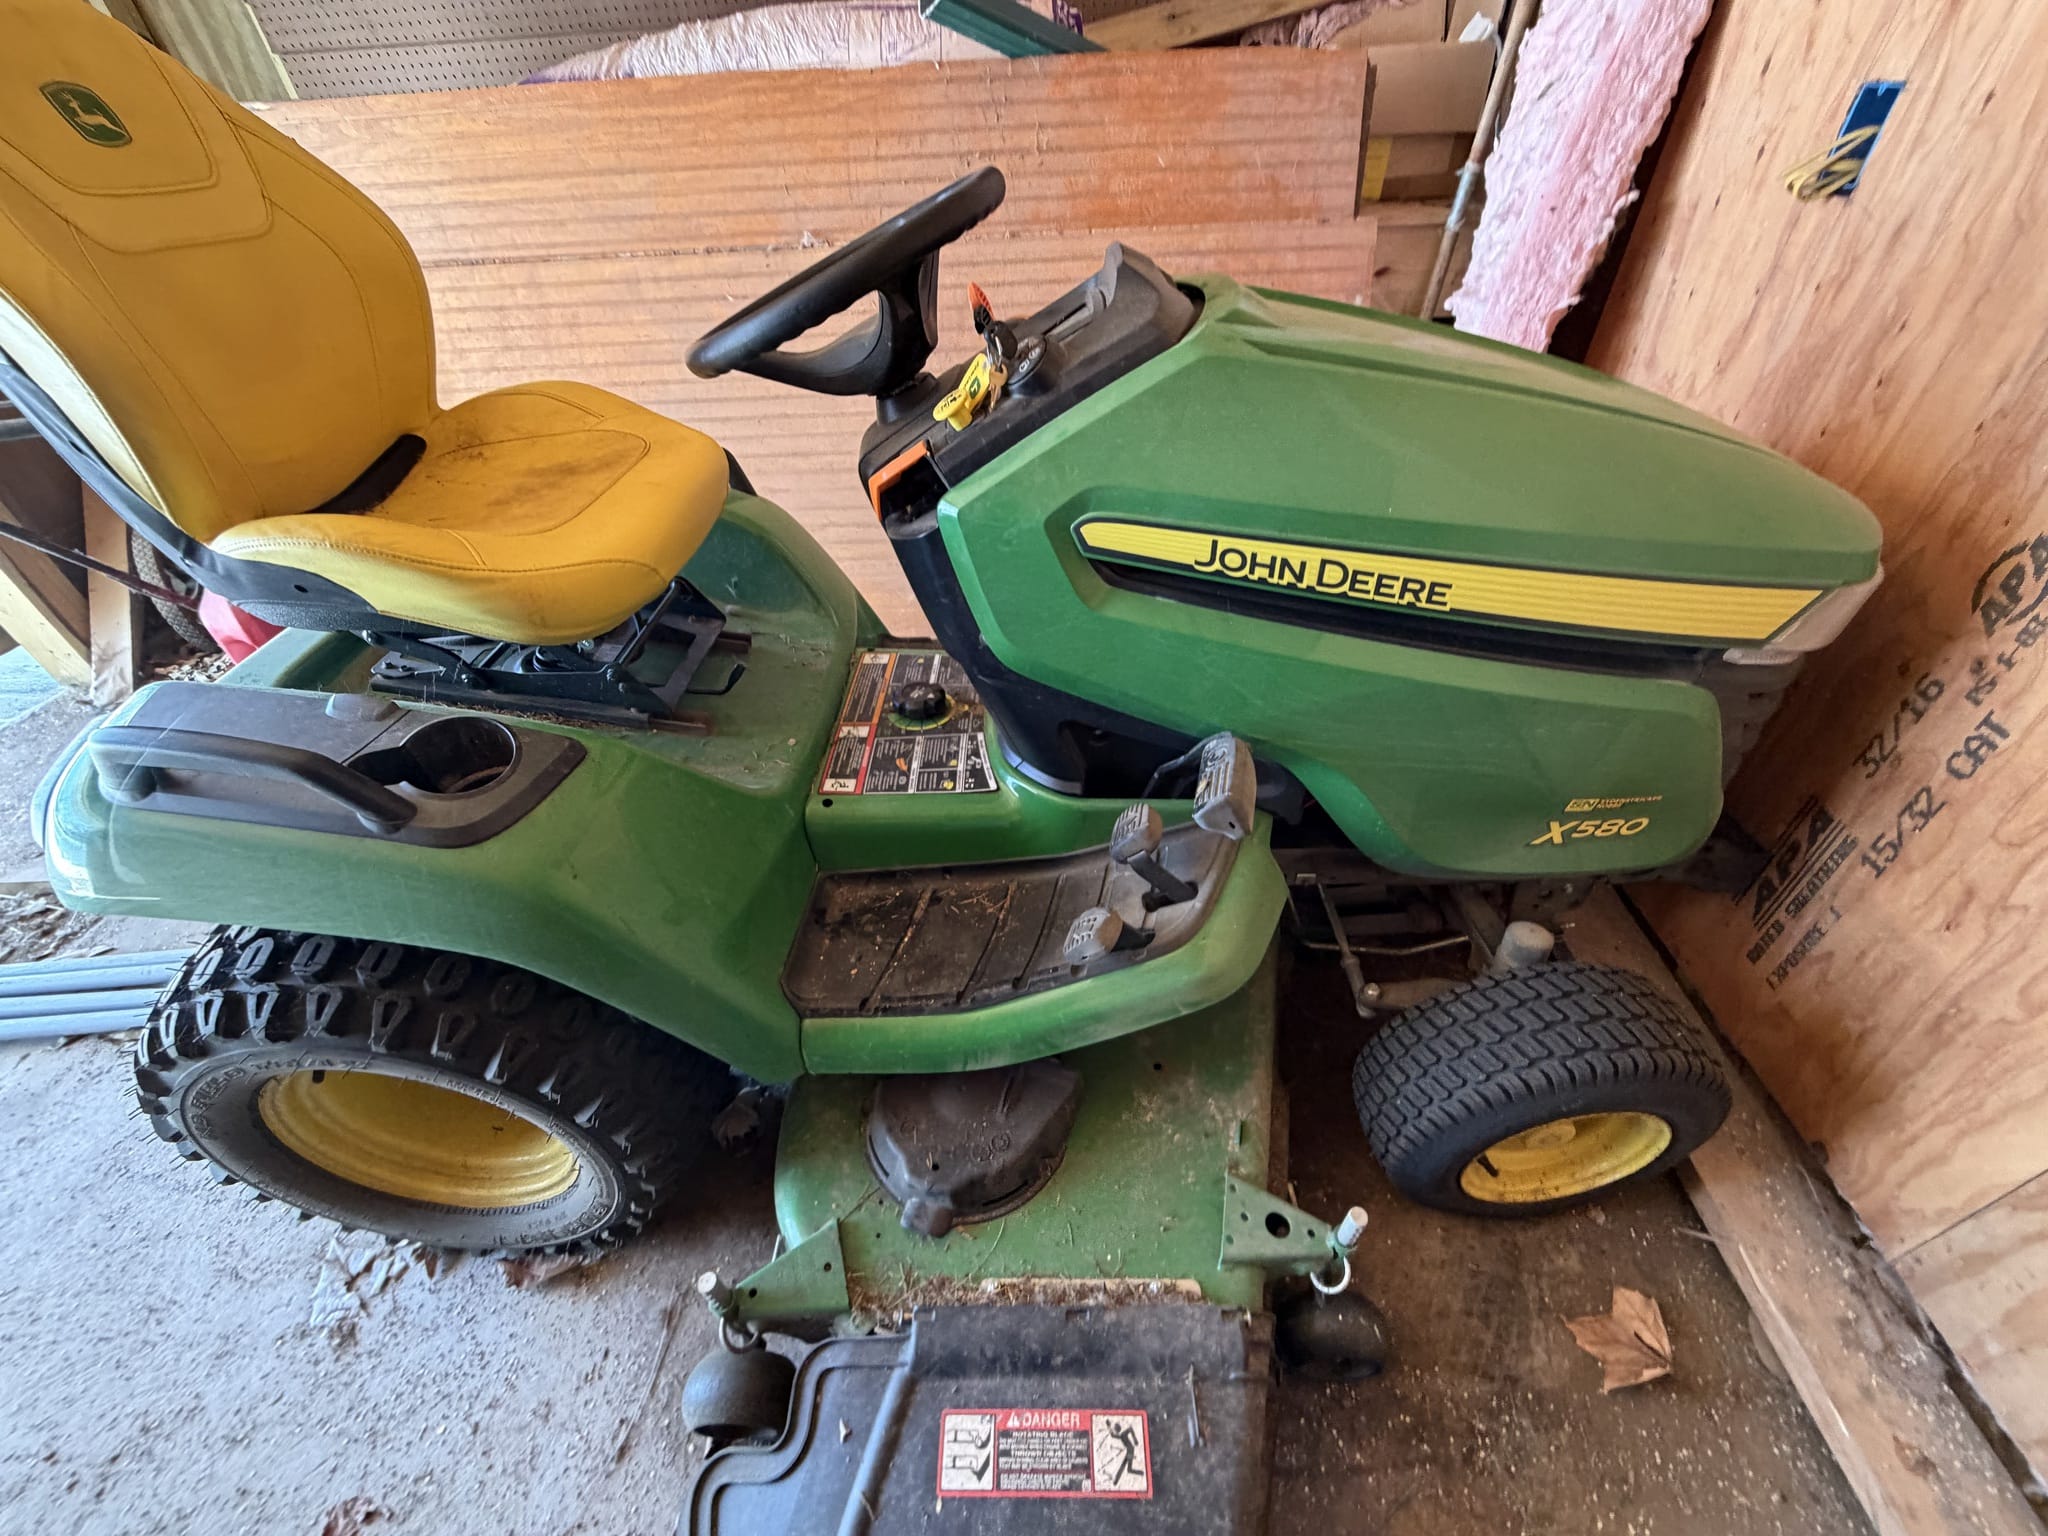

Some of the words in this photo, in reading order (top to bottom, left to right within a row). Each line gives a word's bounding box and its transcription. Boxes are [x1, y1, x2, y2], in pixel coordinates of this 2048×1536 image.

[1194, 539, 1307, 584] JOHN
[1316, 557, 1453, 607] DEERE
[1852, 672, 1945, 779] 32/16
[1529, 817, 1650, 845] X580
[1861, 786, 1948, 879] 15/32
[1946, 709, 2010, 779] CAT
[1752, 806, 1835, 920] APA
[1021, 1411, 1081, 1428] DANGER
